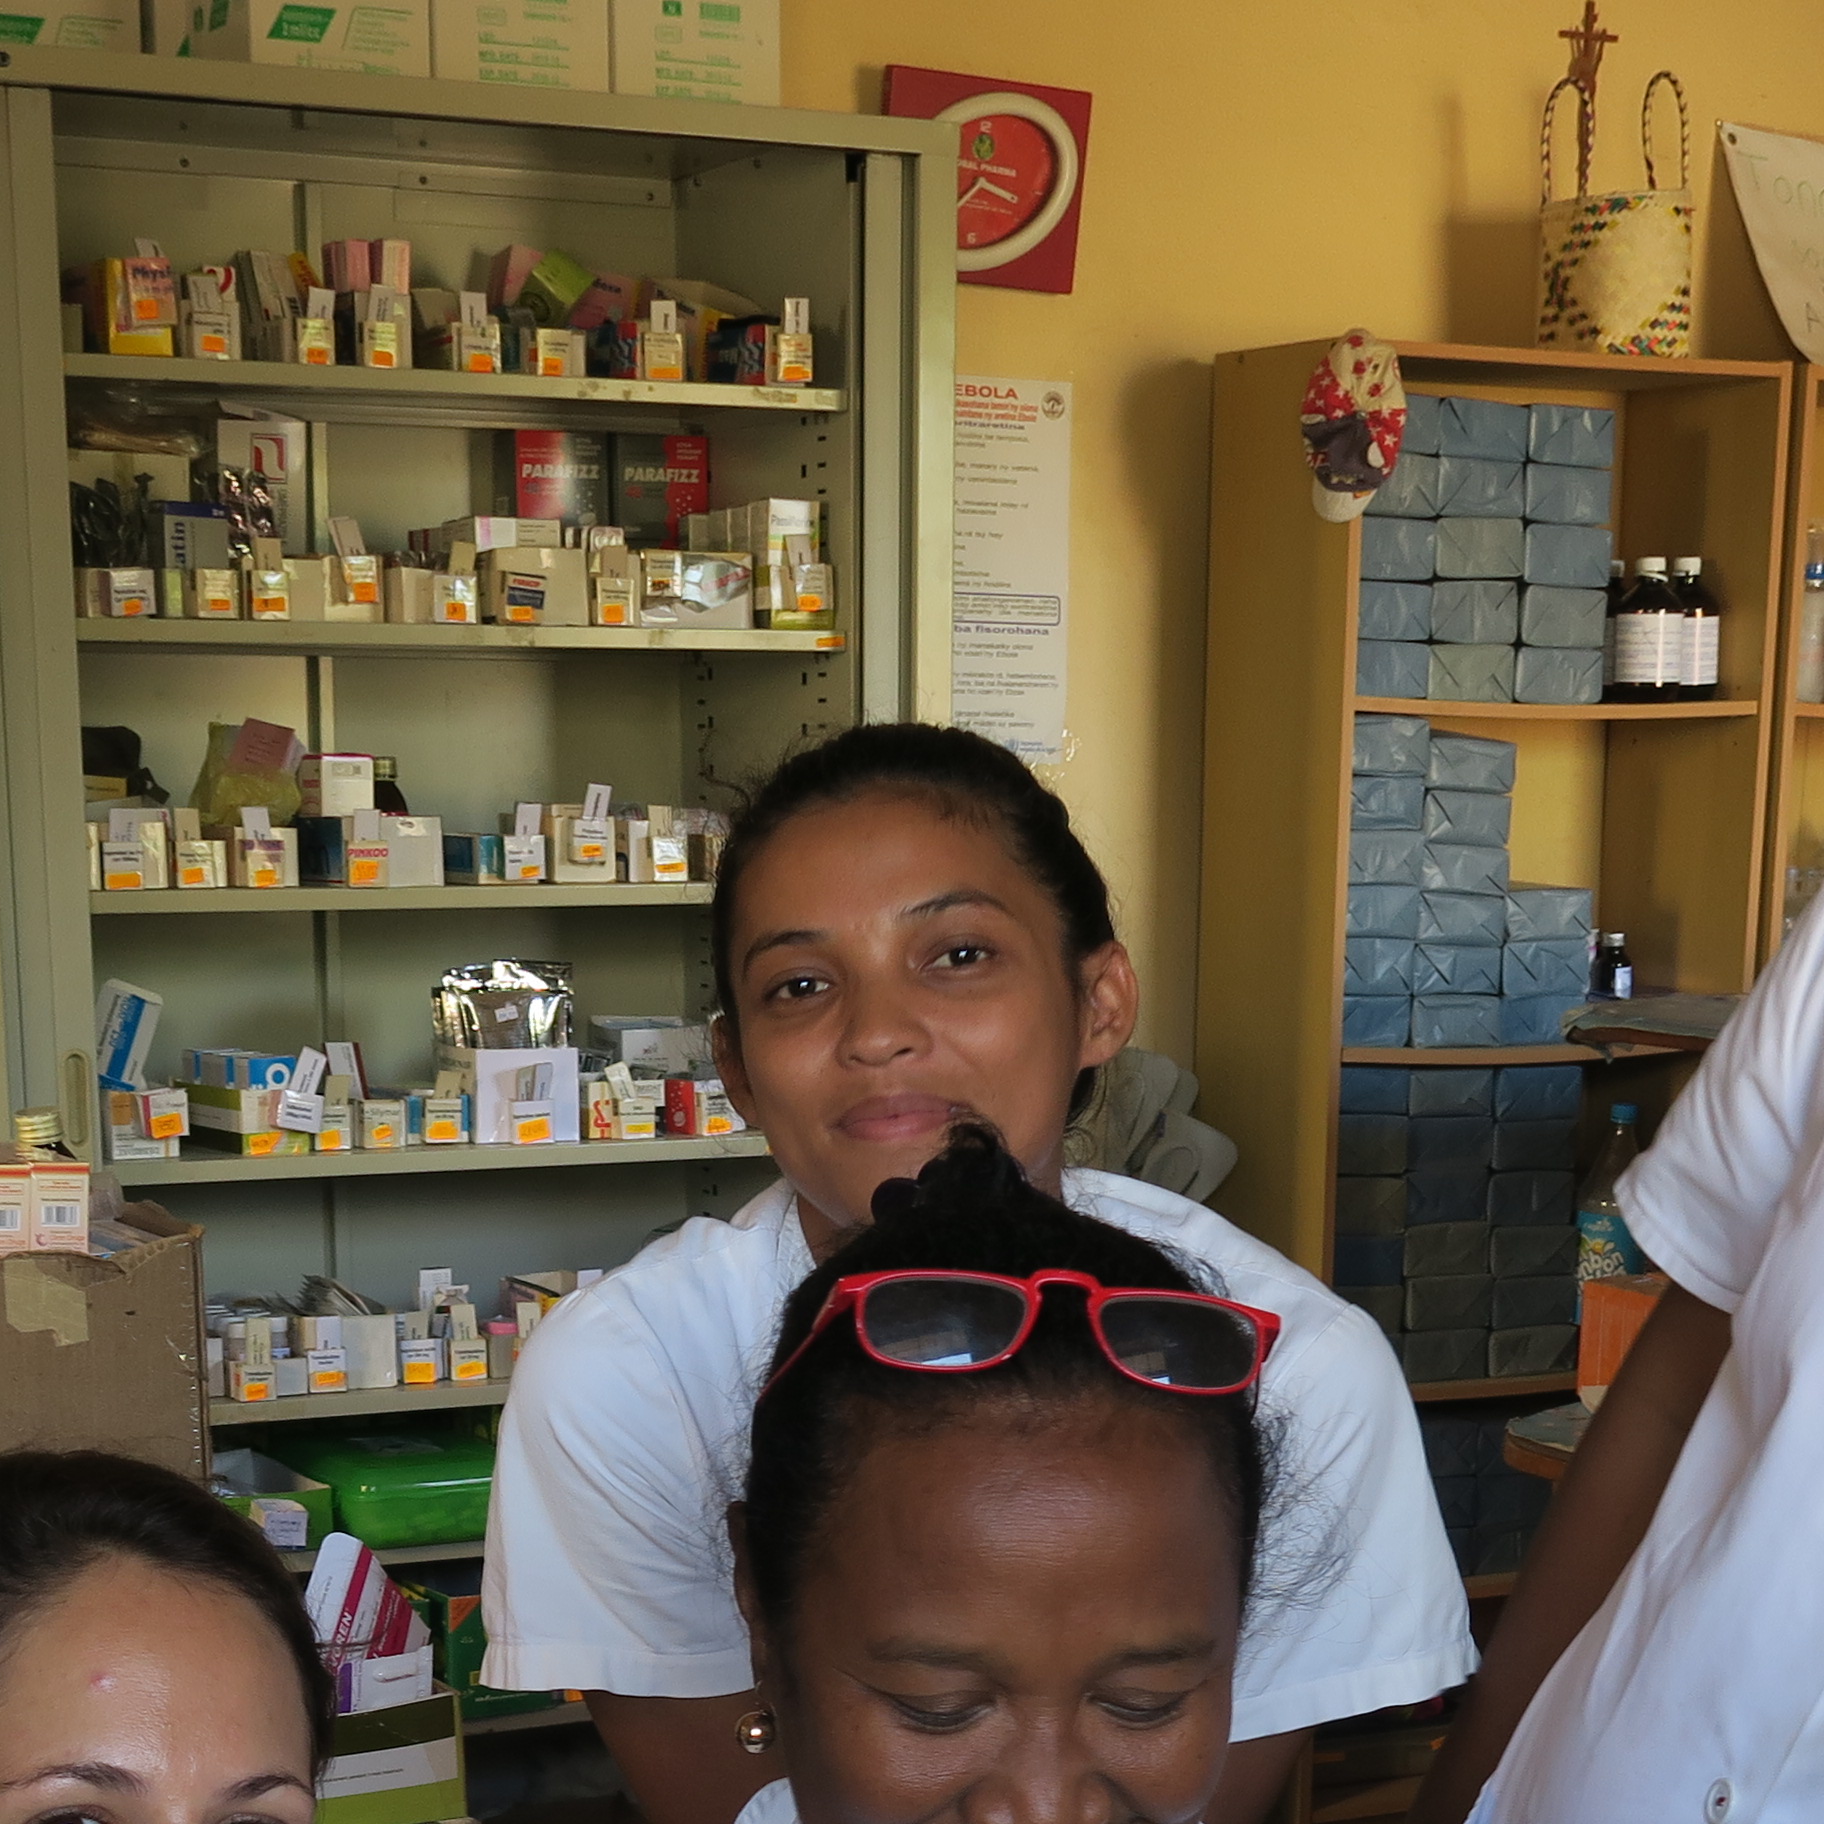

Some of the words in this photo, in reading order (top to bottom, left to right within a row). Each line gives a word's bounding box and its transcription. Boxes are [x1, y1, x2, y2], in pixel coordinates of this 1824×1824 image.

[980, 163, 1016, 177] PHARMA
[955, 384, 1018, 400] EBOLA
[521, 463, 600, 480] PARAFIZZ
[625, 466, 700, 484] PARAFIZZ
[976, 625, 1049, 635] fisorohana
